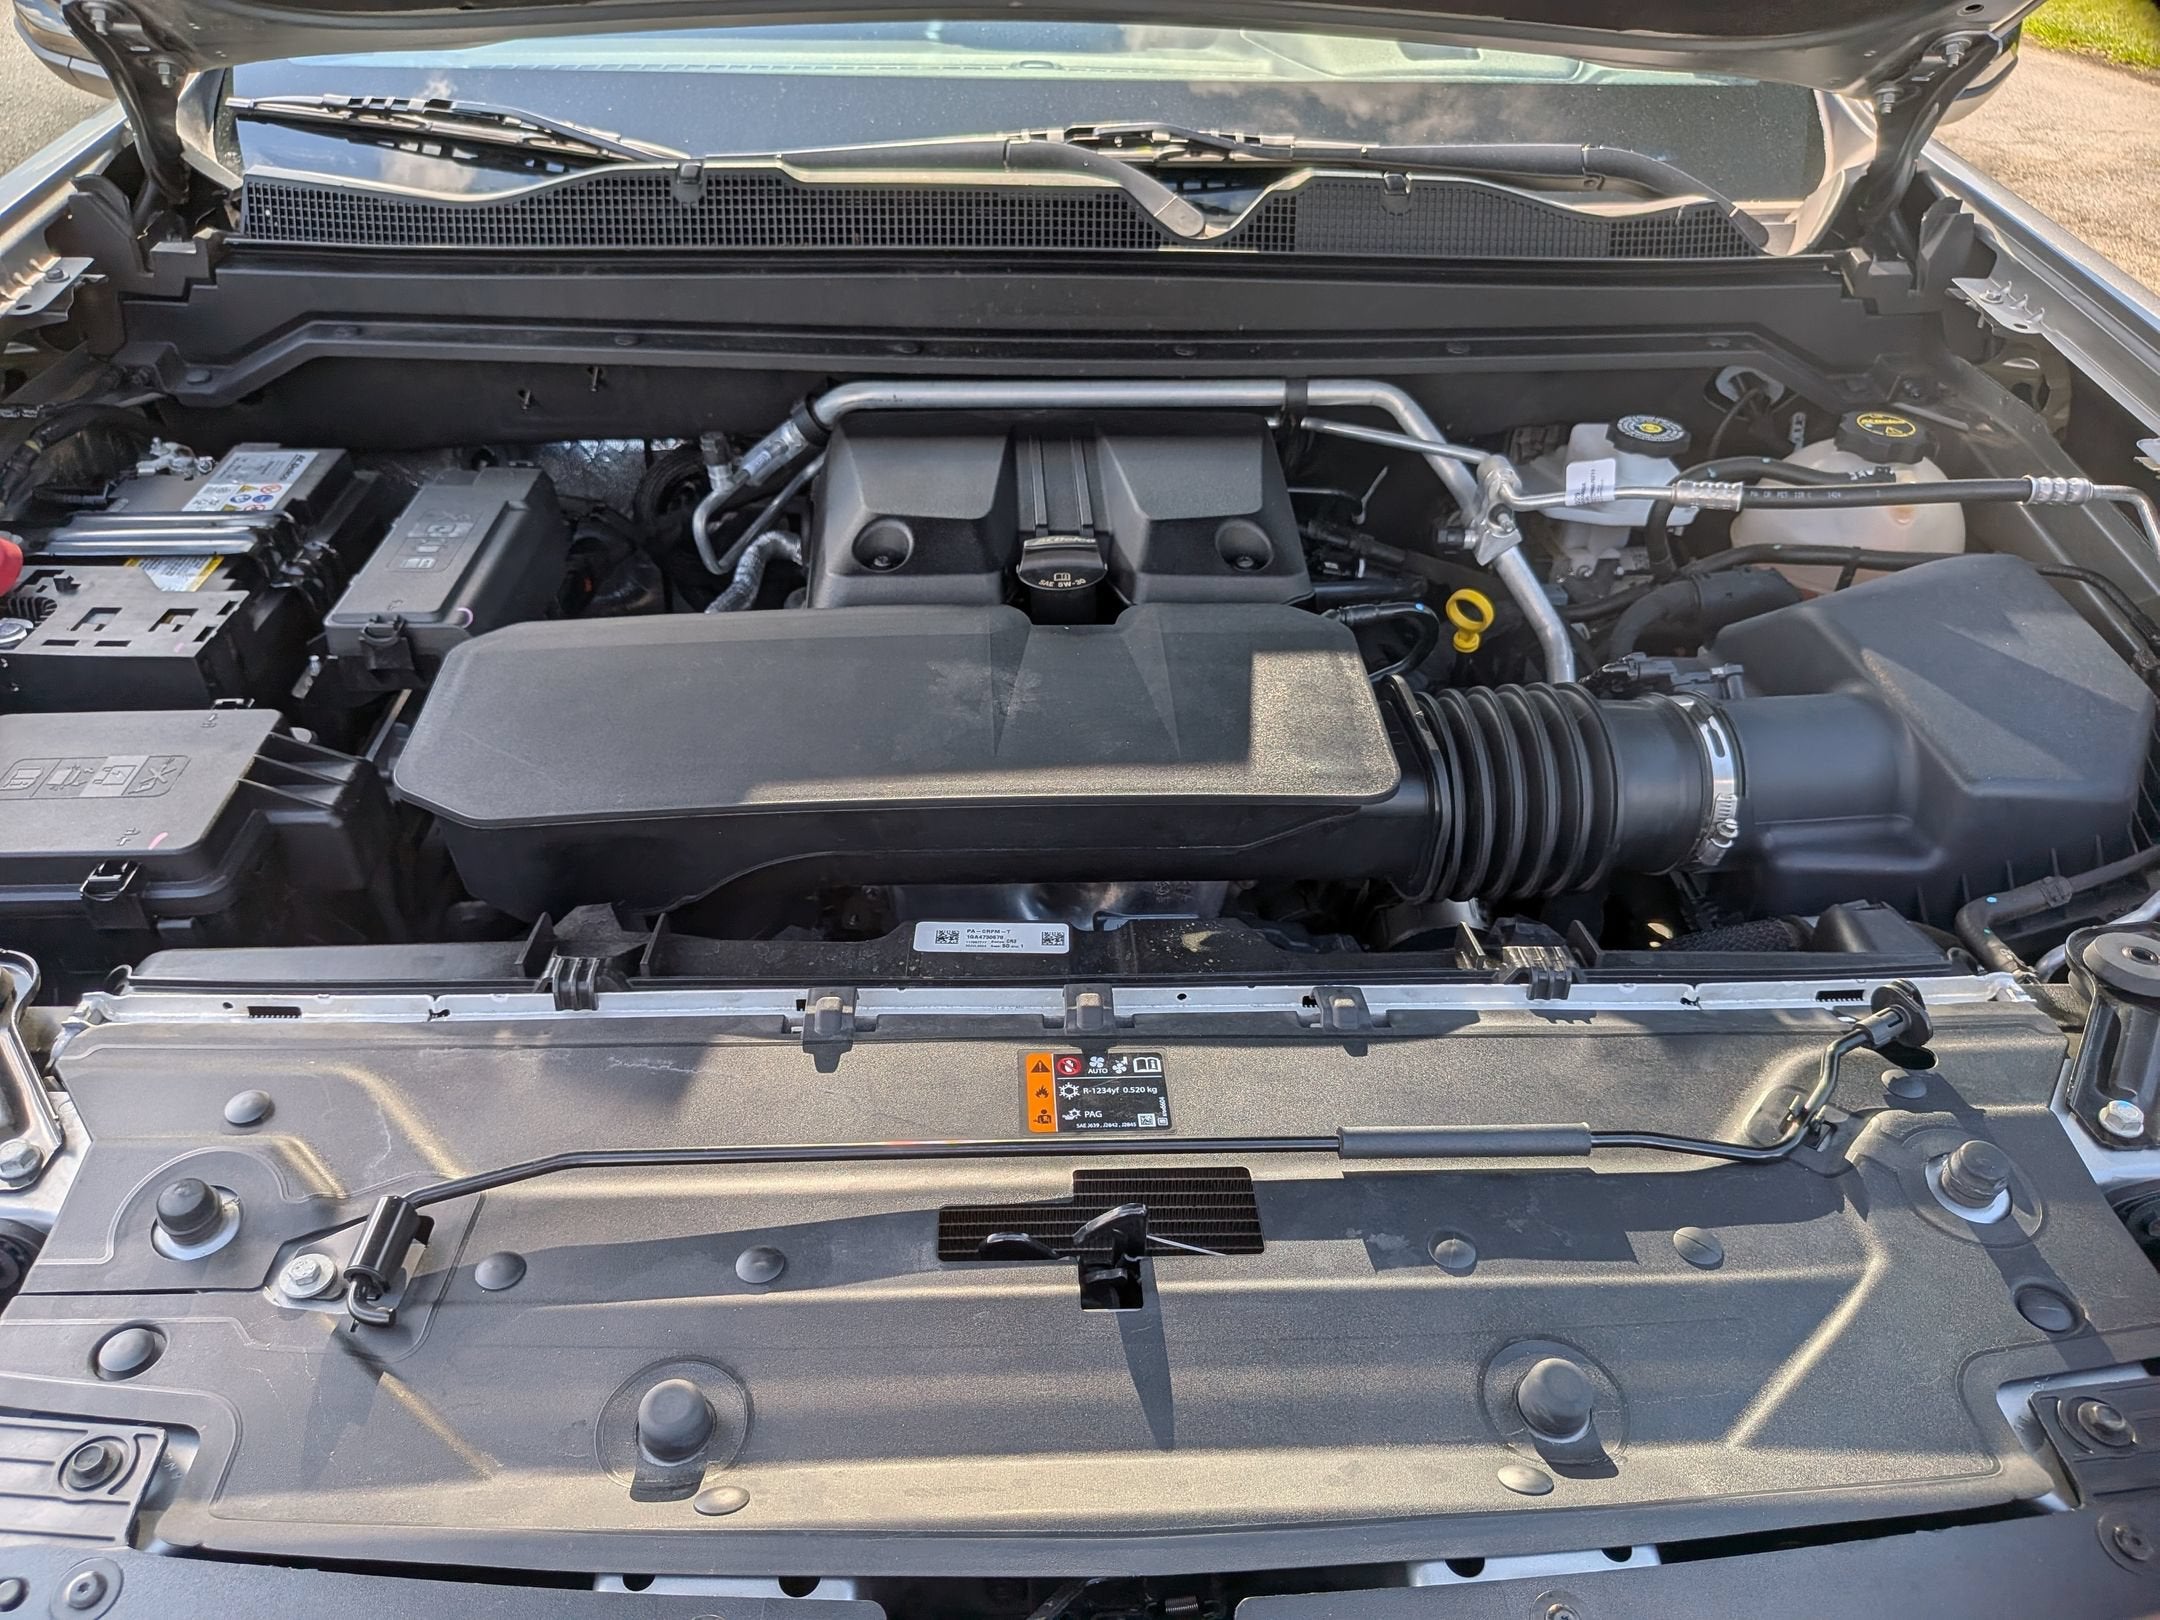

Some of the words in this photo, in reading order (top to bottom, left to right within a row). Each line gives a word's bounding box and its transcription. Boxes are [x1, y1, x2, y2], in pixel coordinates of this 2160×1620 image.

[1083, 1087, 1119, 1095] R-1234yf
[1122, 1086, 1146, 1094] 0.520
[1147, 1086, 1158, 1095] kg
[1084, 1110, 1103, 1118] PAG
